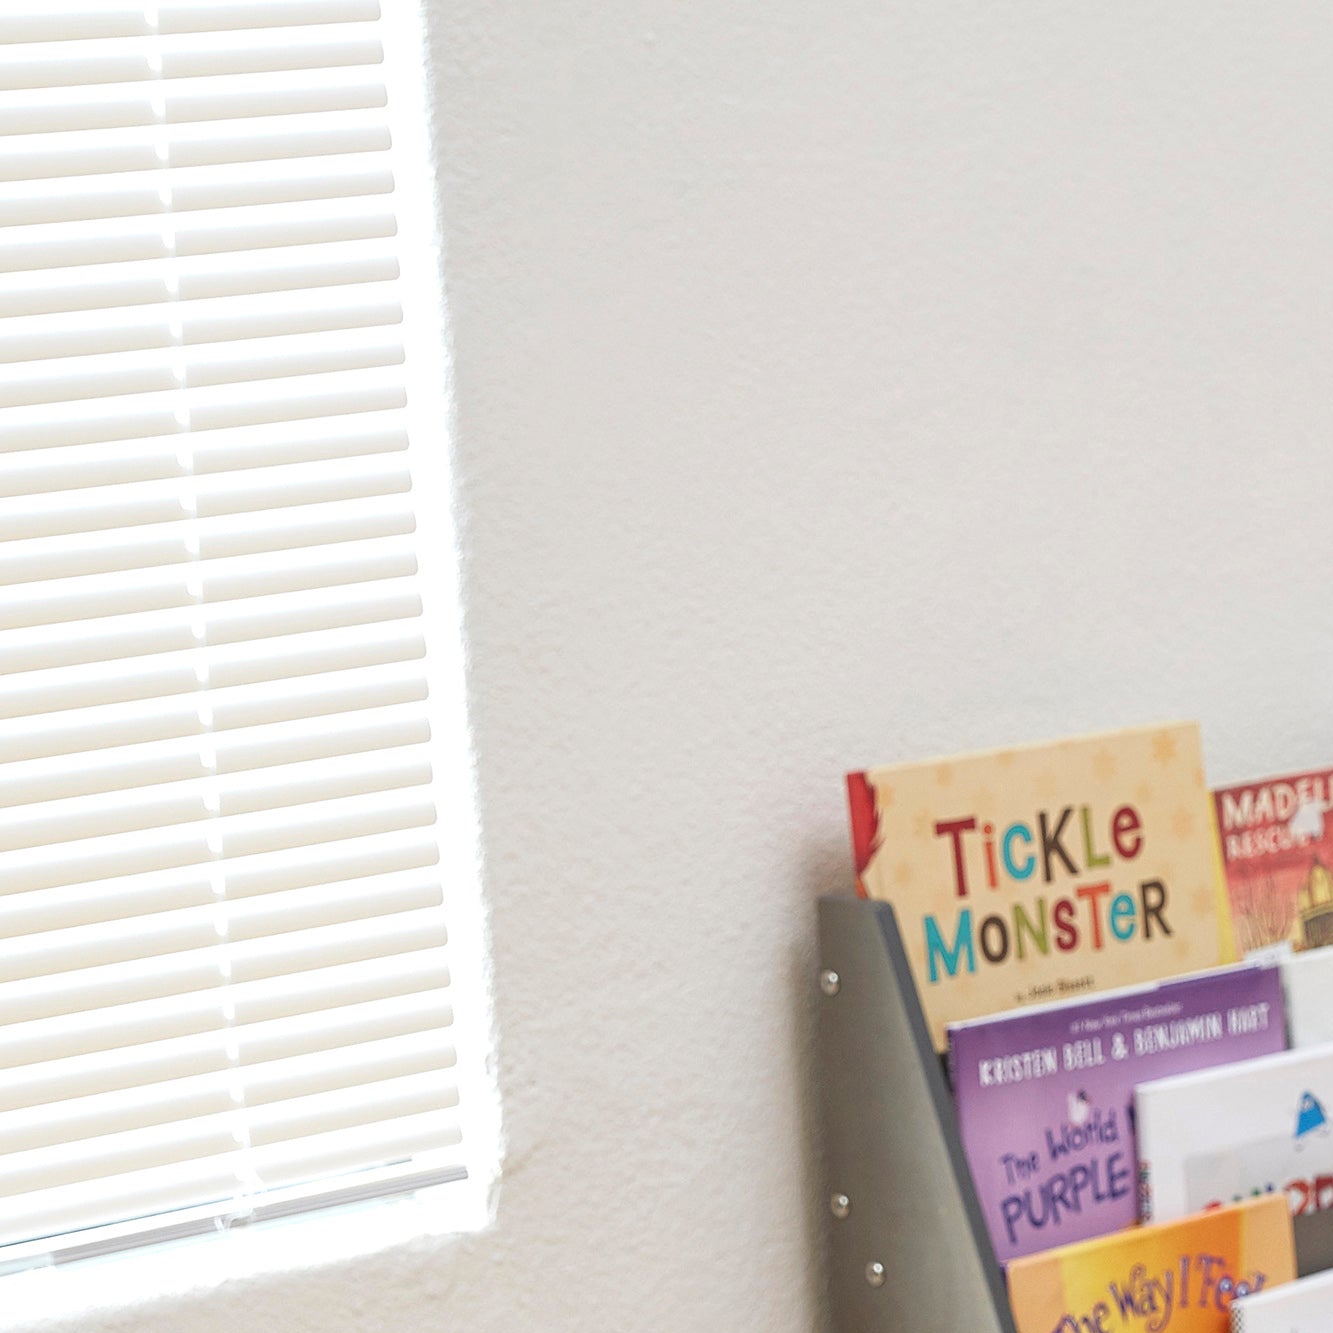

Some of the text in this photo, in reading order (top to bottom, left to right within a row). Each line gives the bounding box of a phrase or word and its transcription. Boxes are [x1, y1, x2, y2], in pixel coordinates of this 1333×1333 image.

[979, 1047, 1058, 1088] KRISTEN
[1063, 1036, 1105, 1072] BELL
[1111, 1032, 1129, 1061] &
[1133, 1012, 1223, 1056] BENJAMIN
[1000, 1108, 1119, 1184] The World
[1000, 1153, 1132, 1245] PURPLE
[1179, 1254, 1190, 1309] I
